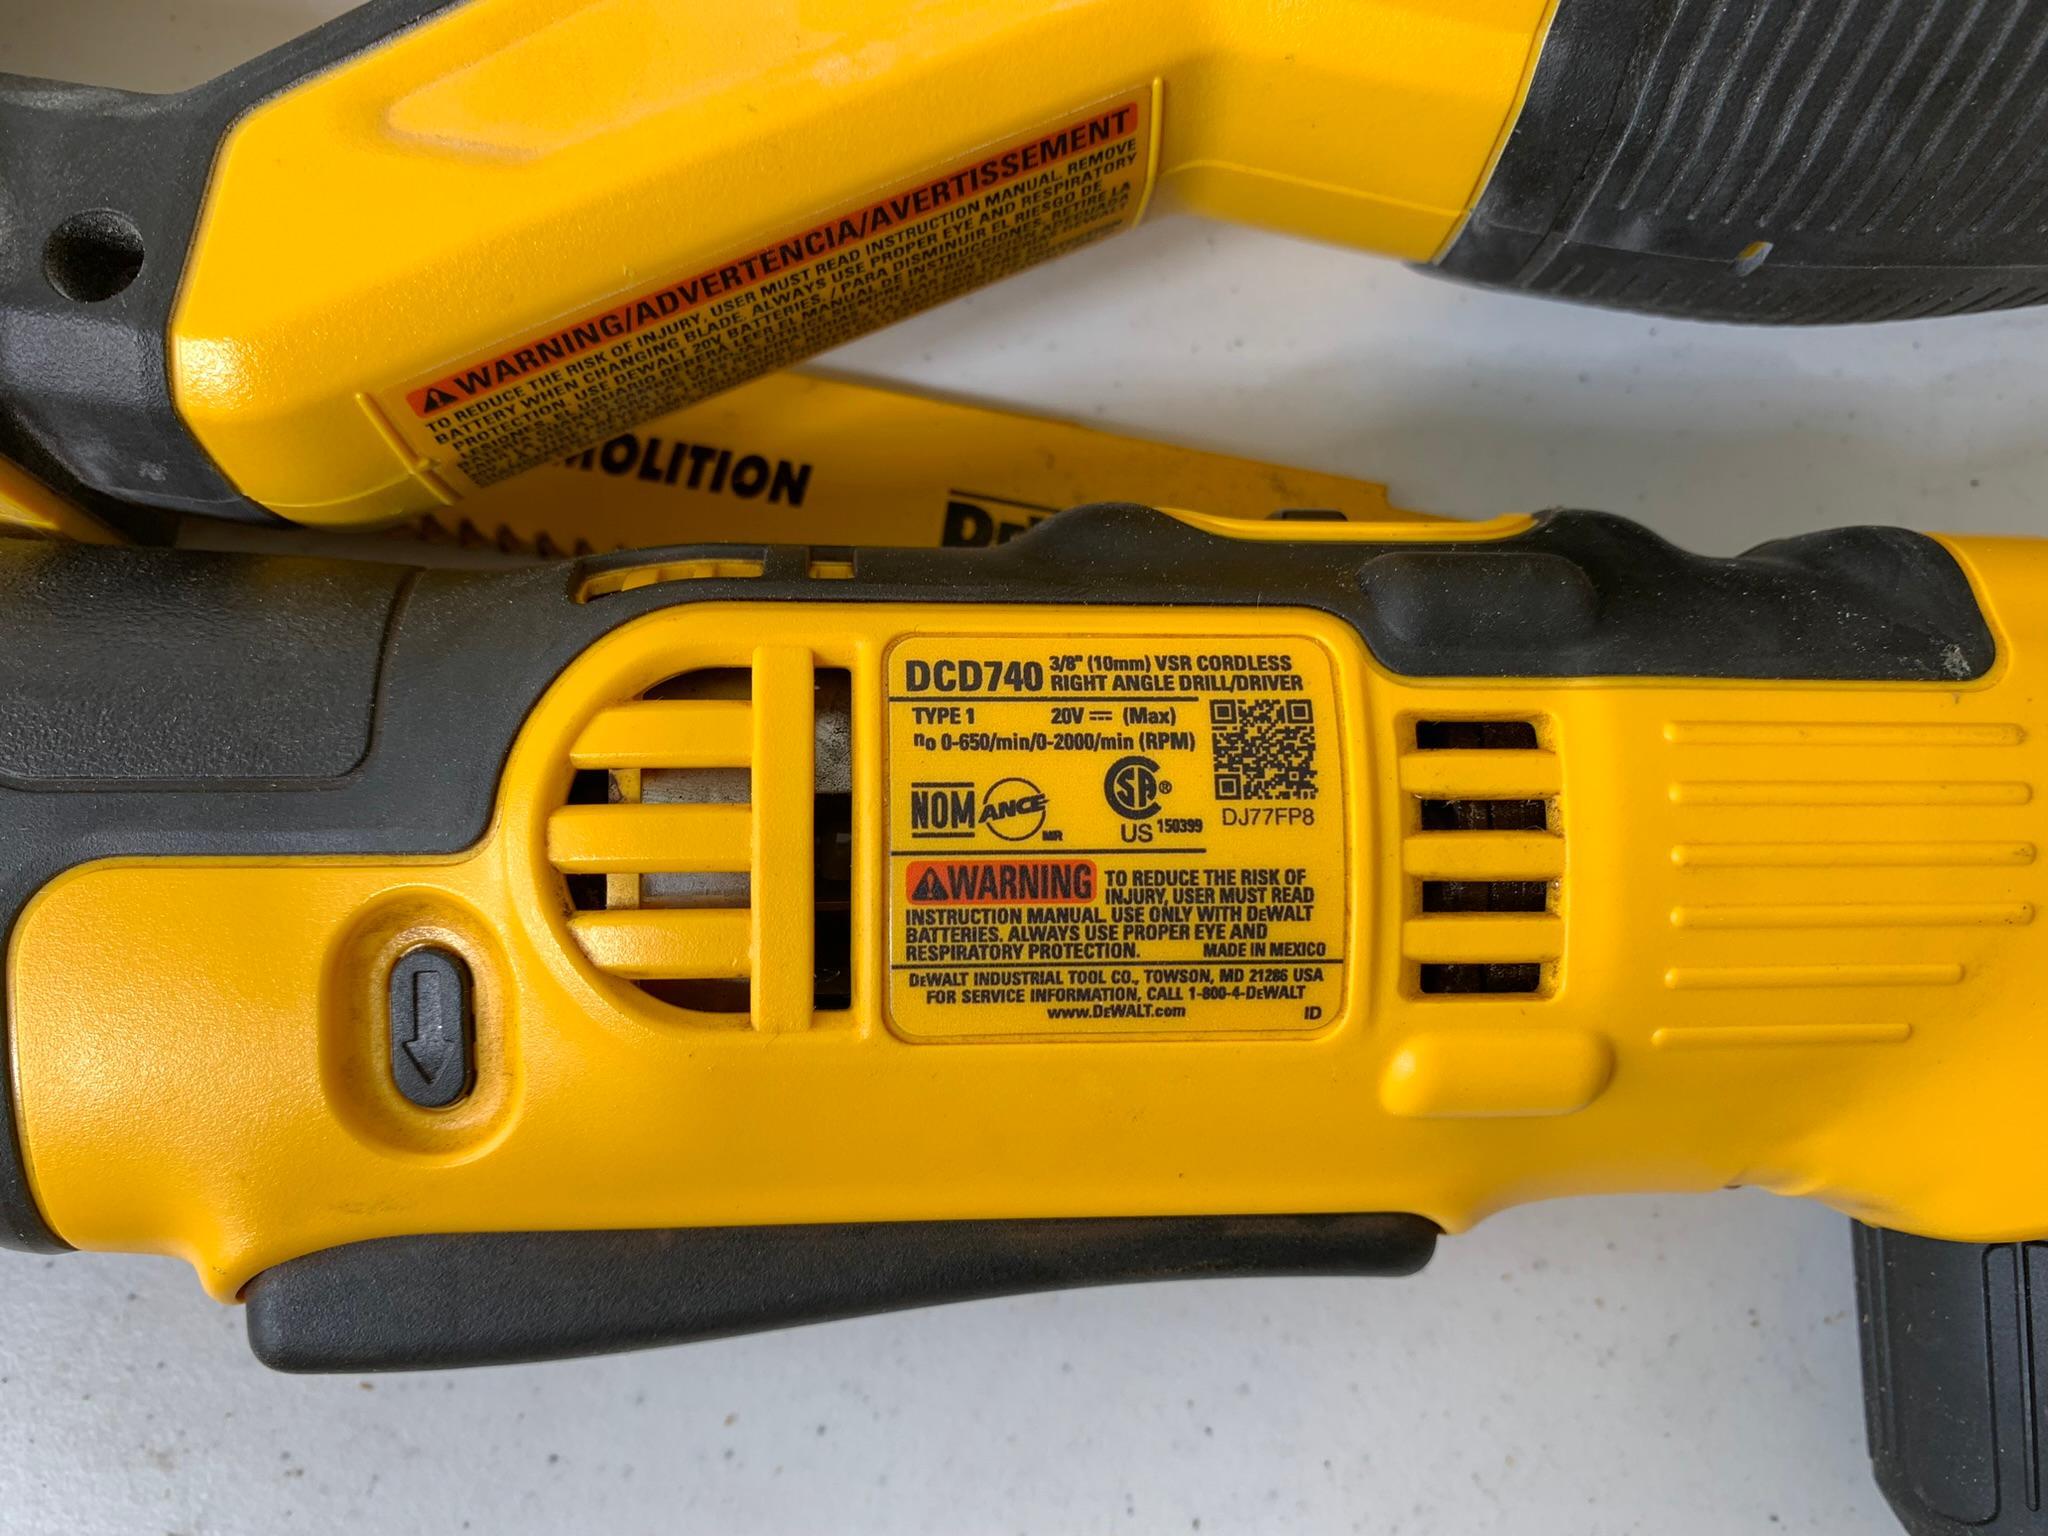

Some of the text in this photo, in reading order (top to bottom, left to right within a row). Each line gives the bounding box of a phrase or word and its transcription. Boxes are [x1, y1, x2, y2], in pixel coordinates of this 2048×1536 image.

[451, 106, 1130, 397] WARNING/ADVERTENCIA/AVERTISSEMENT
[800, 282, 877, 321] MANUAL
[880, 271, 903, 289] DE
[1111, 179, 1131, 196] LA
[424, 415, 453, 433] TO
[452, 384, 526, 422] REDUCE
[526, 369, 564, 392] THE
[564, 351, 608, 377] RISK
[609, 340, 635, 359] OF
[635, 310, 708, 348] INJURY,
[709, 290, 757, 319] USER
[759, 267, 812, 299] MUST
[814, 247, 861, 276] READ
[865, 199, 980, 256] INSTRUCTION
[1067, 136, 1136, 176] REMOVE
[573, 379, 611, 402] USE
[612, 347, 689, 386] DEWALT
[690, 333, 723, 354] 20V
[840, 265, 888, 294] PARA
[891, 226, 986, 273] DISMINUIR
[990, 216, 1010, 234] EL
[1014, 189, 1075, 224] RIESGO
[1080, 178, 1103, 198] DE
[433, 403, 519, 445] BATTERY
[519, 378, 580, 410] WHEN
[581, 337, 681, 385] CHANGING
[750, 276, 828, 317] ALWAYS
[830, 261, 866, 284] USE
[870, 231, 938, 269] PROPER
[942, 217, 973, 240] EYE
[978, 200, 1016, 226] AND
[1021, 151, 1137, 208] RESPIRATORY
[563, 433, 813, 508] OLITION
[1087, 655, 1151, 673] (10mm)
[1155, 655, 1192, 671] VSR
[1197, 655, 1292, 672] CORDLESS
[906, 660, 1043, 692] DCD740
[1051, 675, 1304, 693] RIGHT ANGLE DRILL/DRIVER
[912, 707, 975, 724] TYPE 1
[1051, 707, 1176, 726] 20V (Max)
[941, 732, 1134, 752] 0-650/min/0-2000/min
[1139, 732, 1196, 752] (RPM)
[911, 791, 975, 829] NOM
[978, 793, 1050, 824] ANCE
[1222, 808, 1315, 826] DJ77FP8
[1121, 824, 1153, 842] US
[1157, 818, 1203, 833] 150399
[947, 863, 1092, 900] WARNING
[1104, 869, 1306, 886] TO REDUCE THE RISK OF
[1105, 887, 1314, 905] INJURY, USER MUST READ
[906, 908, 1022, 926] INSTRUCTION
[1111, 906, 1144, 923] USE
[1149, 906, 1192, 922] ONLY
[1197, 906, 1242, 922] WITH
[906, 923, 1267, 944] BATTERIES. ALWAYS USE PROPER EYE AND
[906, 942, 1140, 962] RESPIRATORY PROTECTION.
[1203, 942, 1326, 958] MADE IN MEXICO
[974, 971, 1063, 986] INDUSTRIAL
[1068, 970, 1106, 985] TOOL
[1111, 969, 1139, 985] CO.,
[1144, 969, 1214, 985] TOWSON,
[1219, 968, 1244, 983] MD
[1249, 968, 1288, 983] 21286
[1293, 968, 1324, 983] USA
[926, 990, 956, 1004] FOR
[961, 988, 1025, 1003] SERVICE
[1030, 987, 1141, 1003] INFORMATION,
[1146, 986, 1183, 1001] CALL
[1304, 1006, 1322, 1020] ID
